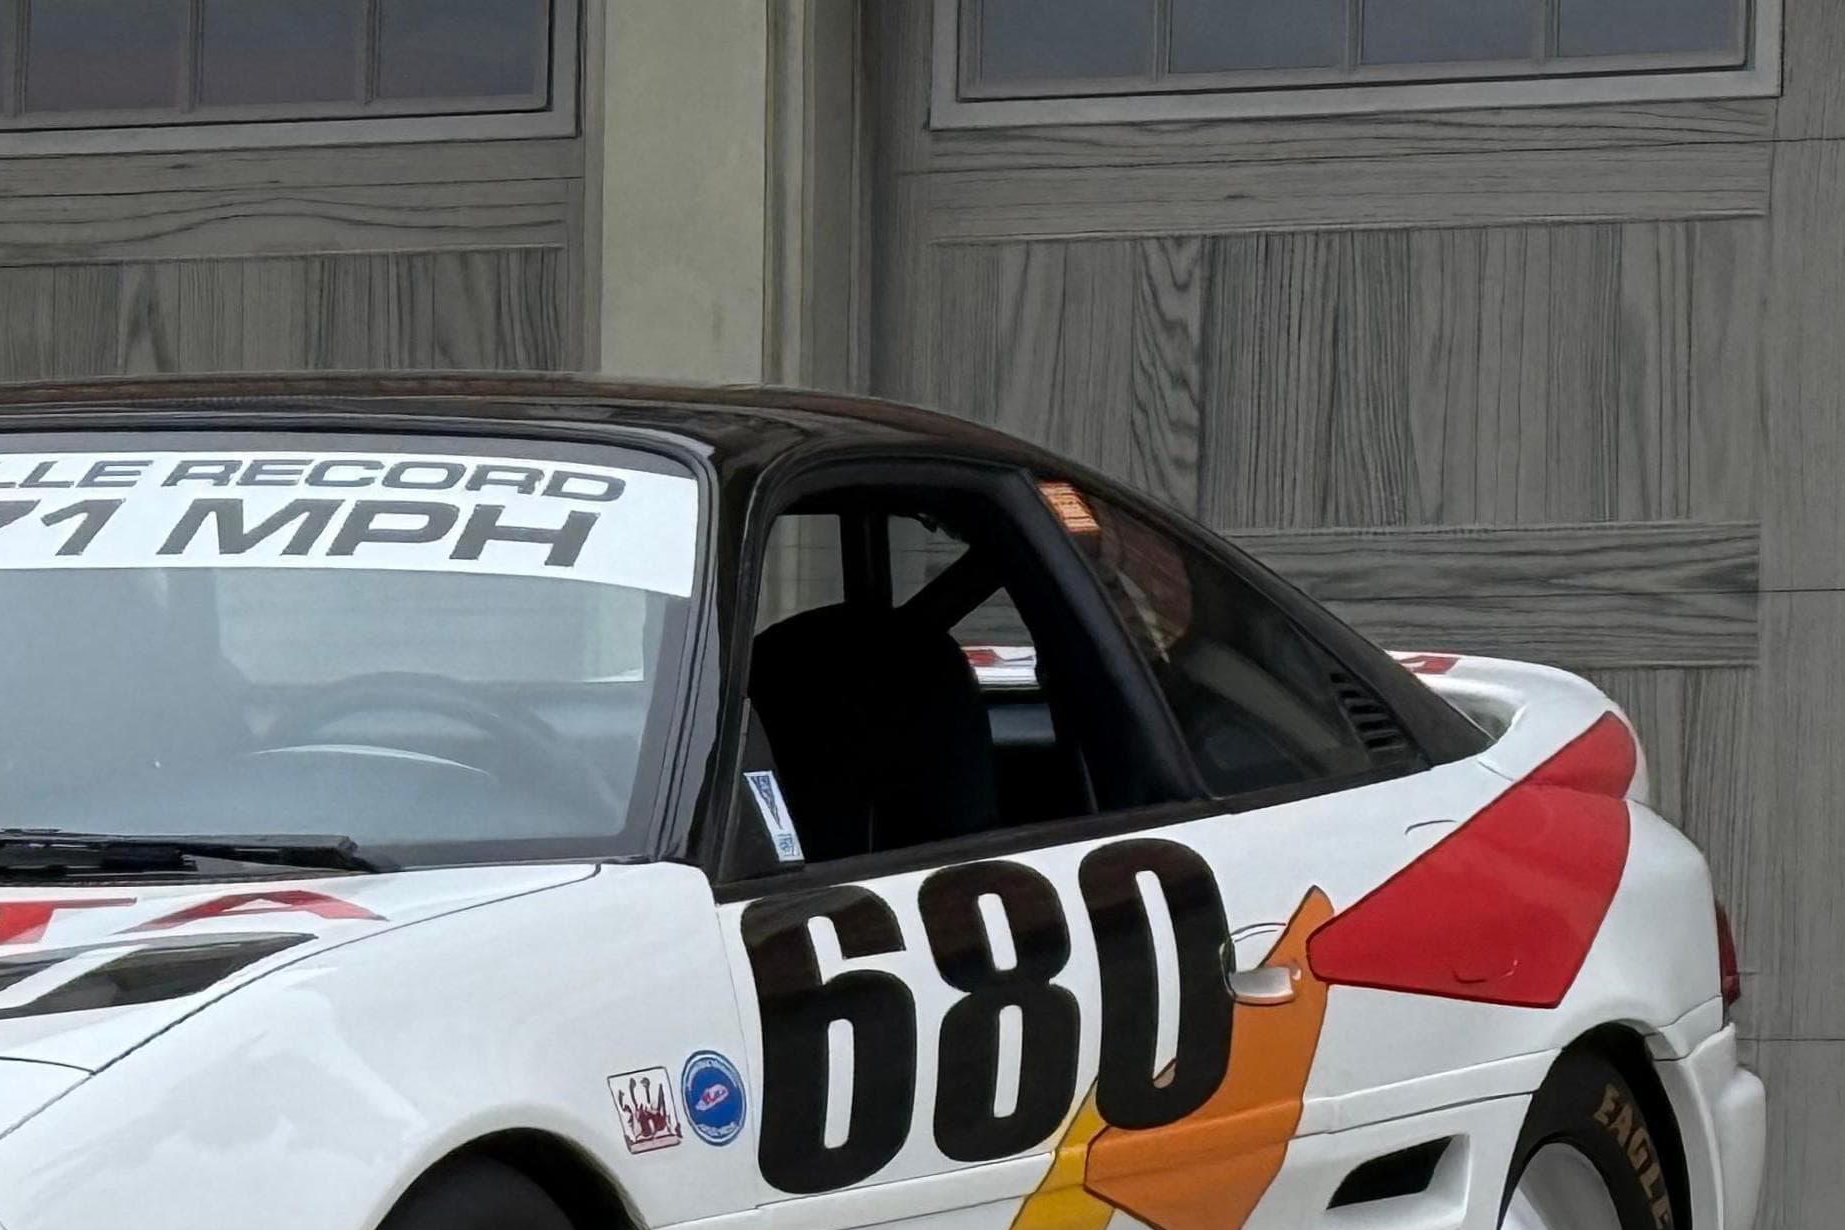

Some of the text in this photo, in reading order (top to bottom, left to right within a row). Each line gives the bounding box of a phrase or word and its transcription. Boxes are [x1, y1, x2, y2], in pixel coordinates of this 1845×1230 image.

[156, 498, 601, 567] MPH
[161, 459, 626, 501] RECORD
[739, 838, 1235, 1194] 680
[1594, 1083, 1674, 1230] EAGLE
